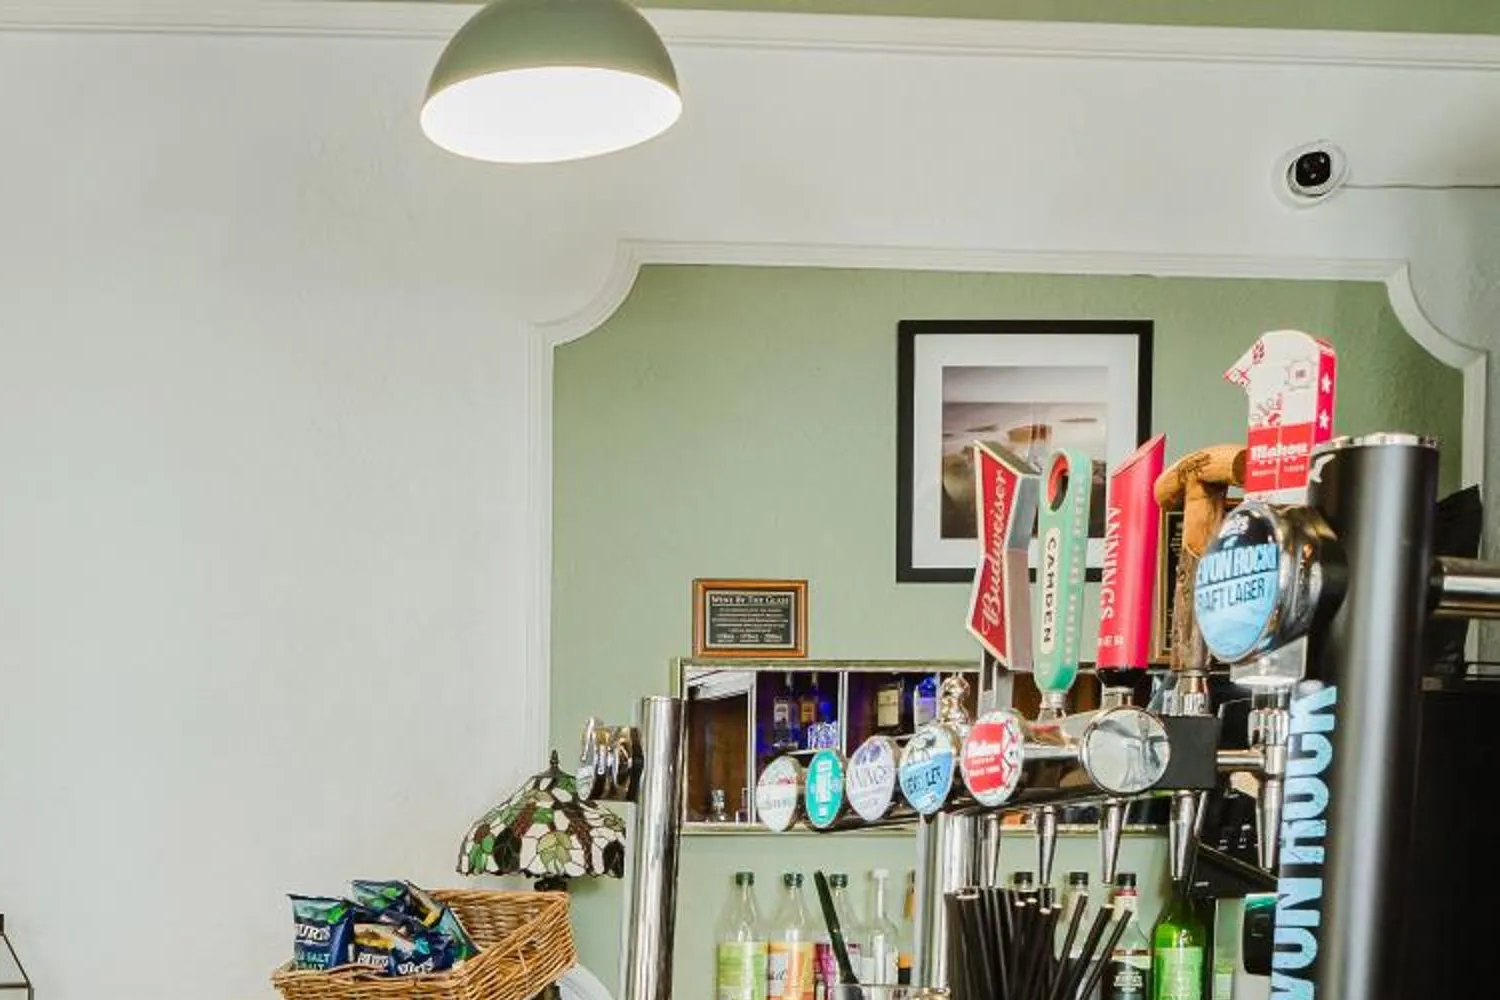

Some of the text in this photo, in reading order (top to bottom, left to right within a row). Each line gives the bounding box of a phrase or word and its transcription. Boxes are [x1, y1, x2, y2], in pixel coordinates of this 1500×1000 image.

[981, 470, 1008, 635] Budweiser
[1043, 537, 1058, 644] CAMDEN
[1227, 577, 1266, 607] LAGER
[1279, 685, 1338, 866] ROCK
